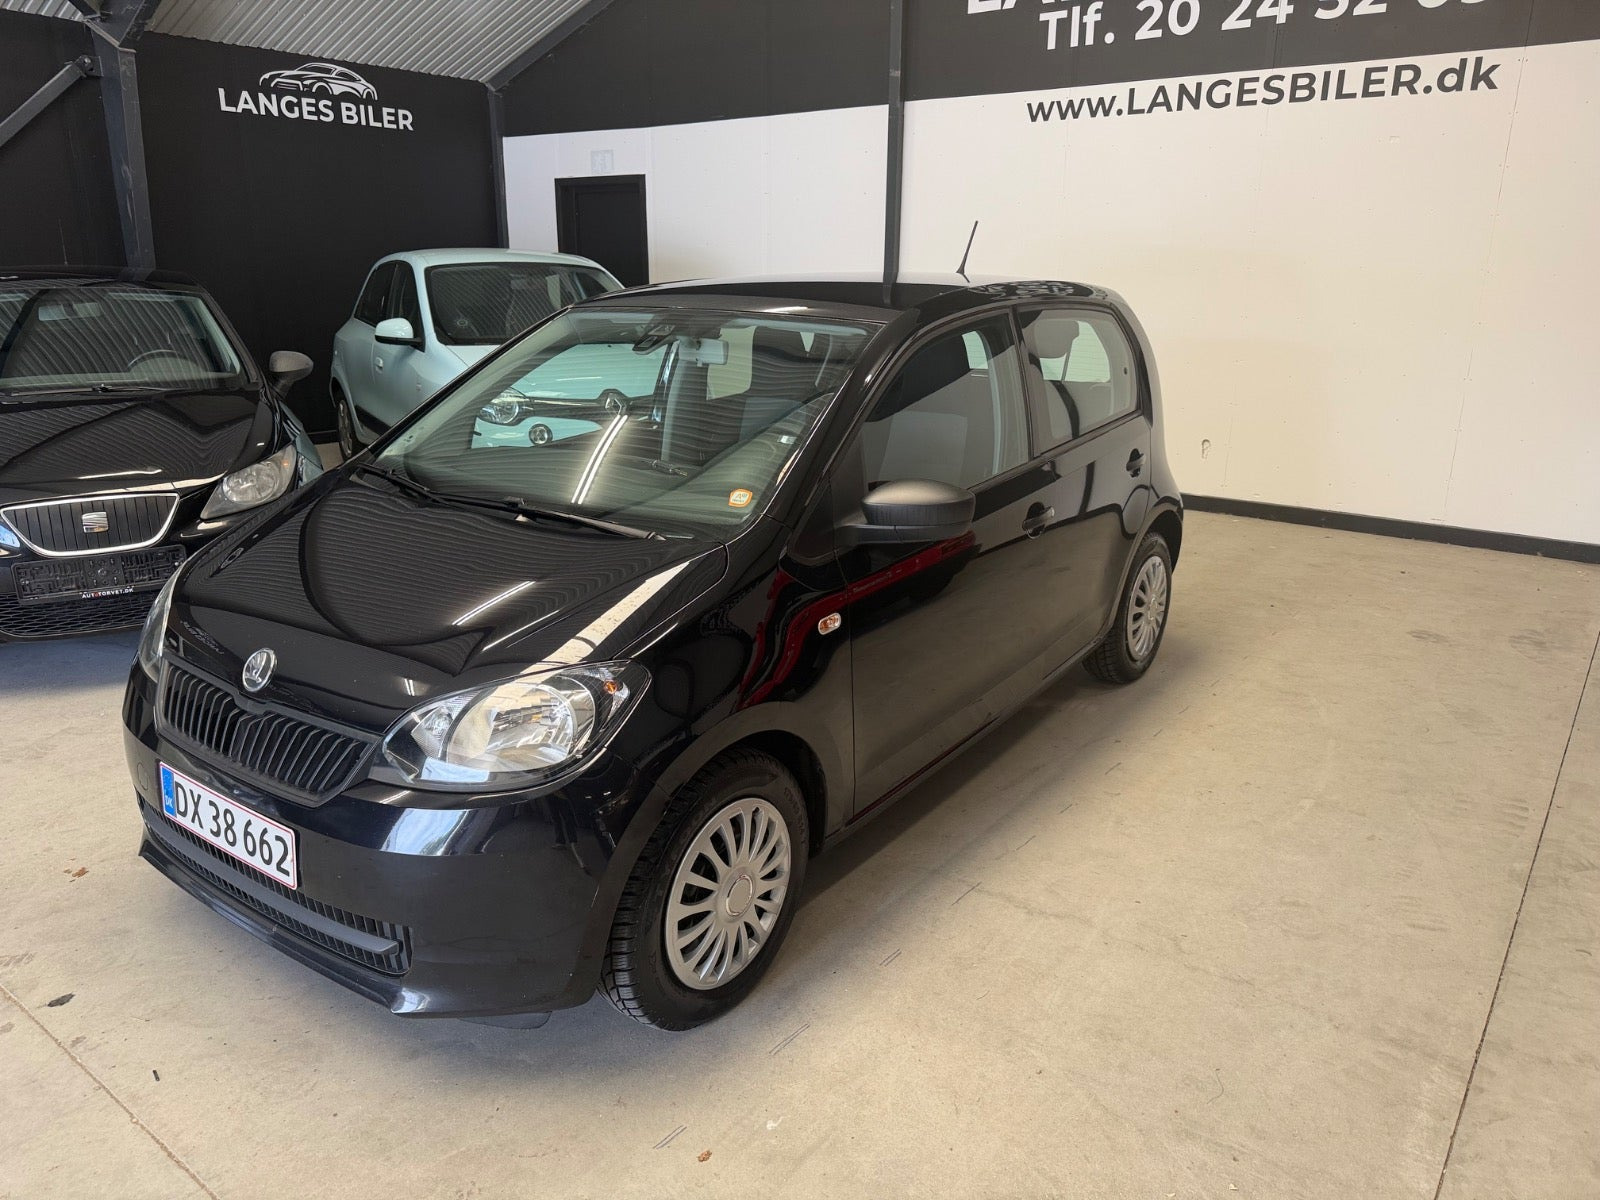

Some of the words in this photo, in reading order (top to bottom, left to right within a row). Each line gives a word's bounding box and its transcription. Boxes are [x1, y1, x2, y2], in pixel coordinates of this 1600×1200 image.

[1039, 1, 1115, 50] Tlf.
[1134, 0, 1201, 40] 20
[217, 87, 335, 122] LANGES
[340, 101, 415, 131] BILER
[1026, 56, 1502, 123] www.LANGESBILER.dk
[174, 780, 204, 830] DX
[208, 799, 237, 848] 38
[243, 818, 290, 877] 662
